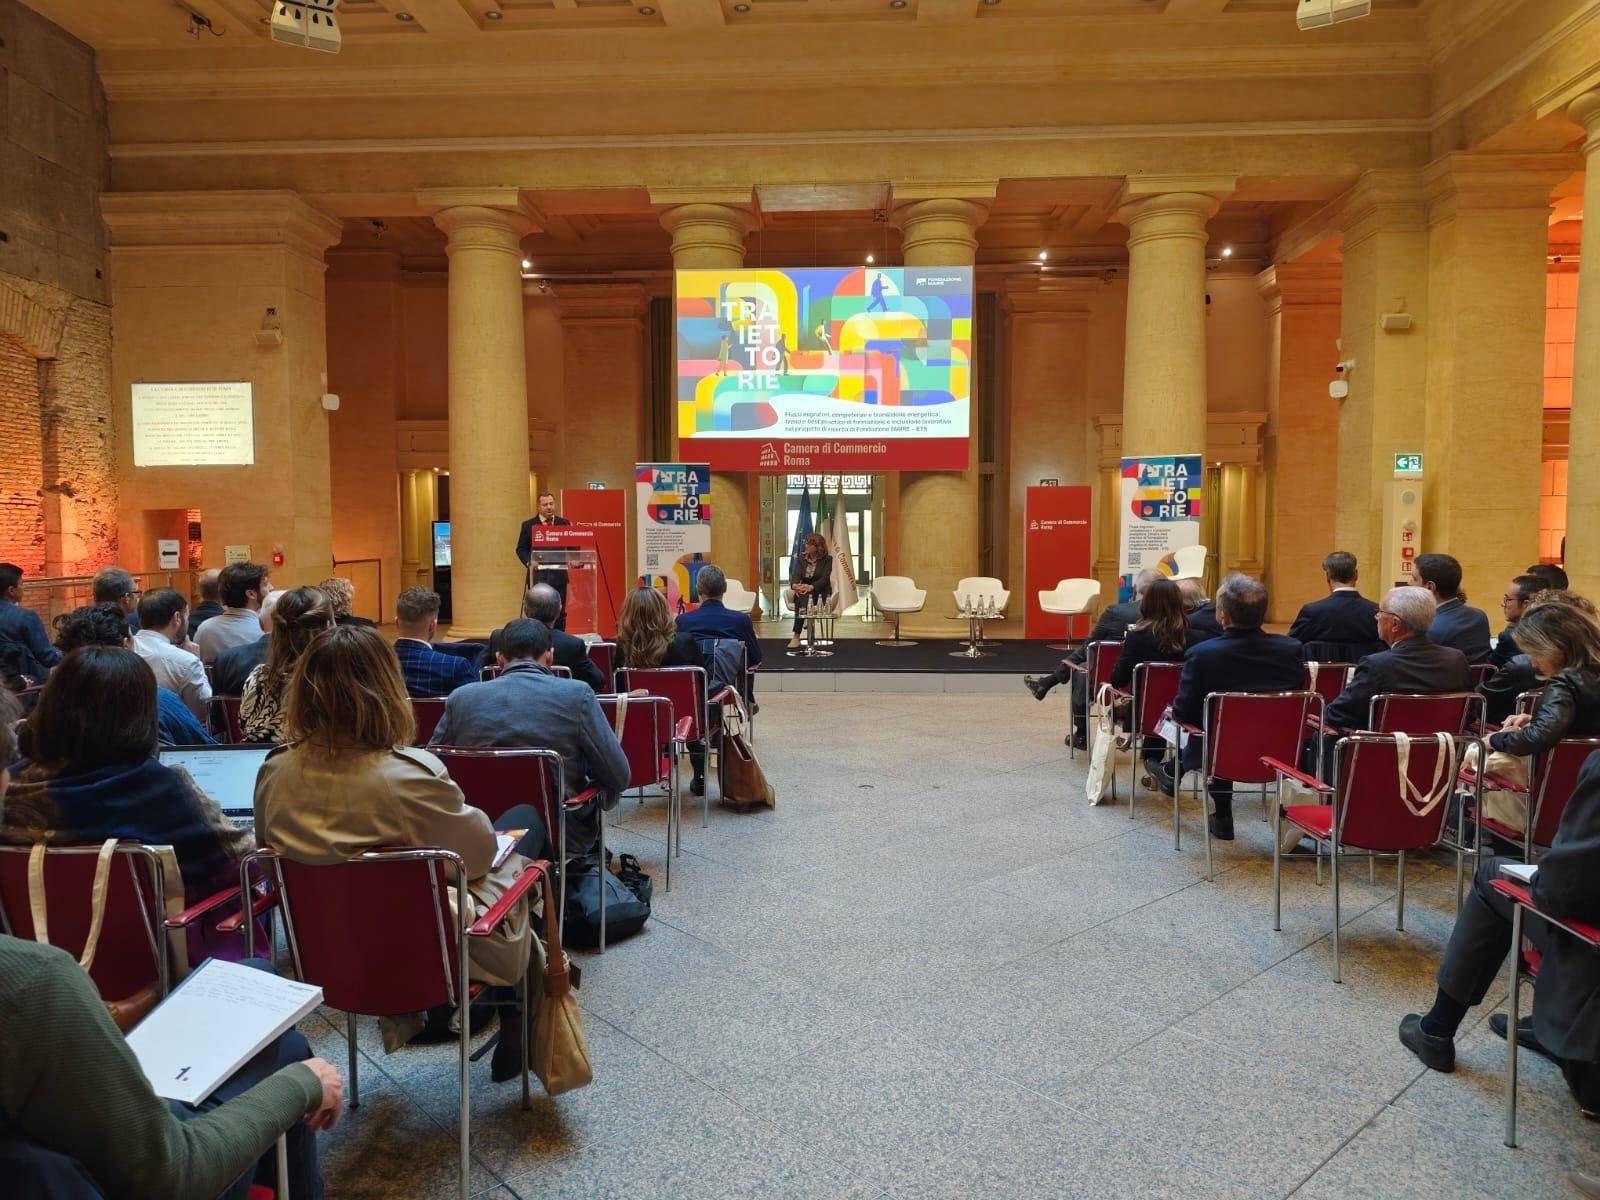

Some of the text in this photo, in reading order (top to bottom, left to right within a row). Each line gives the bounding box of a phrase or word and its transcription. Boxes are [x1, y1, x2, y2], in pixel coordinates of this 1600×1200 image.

[721, 301, 778, 321] TRA
[739, 325, 780, 345] IET
[744, 346, 780, 366] TO
[738, 371, 779, 390] RIE
[783, 442, 887, 454] Camera di Commercio
[783, 455, 811, 466] Roma
[1153, 463, 1188, 477] TRA
[665, 471, 699, 483] TRA
[1161, 477, 1188, 490] IET
[675, 484, 699, 496] IET
[677, 496, 699, 508] TO
[1163, 490, 1187, 504] TO
[674, 509, 699, 521] RIE
[1159, 504, 1187, 517] RIE
